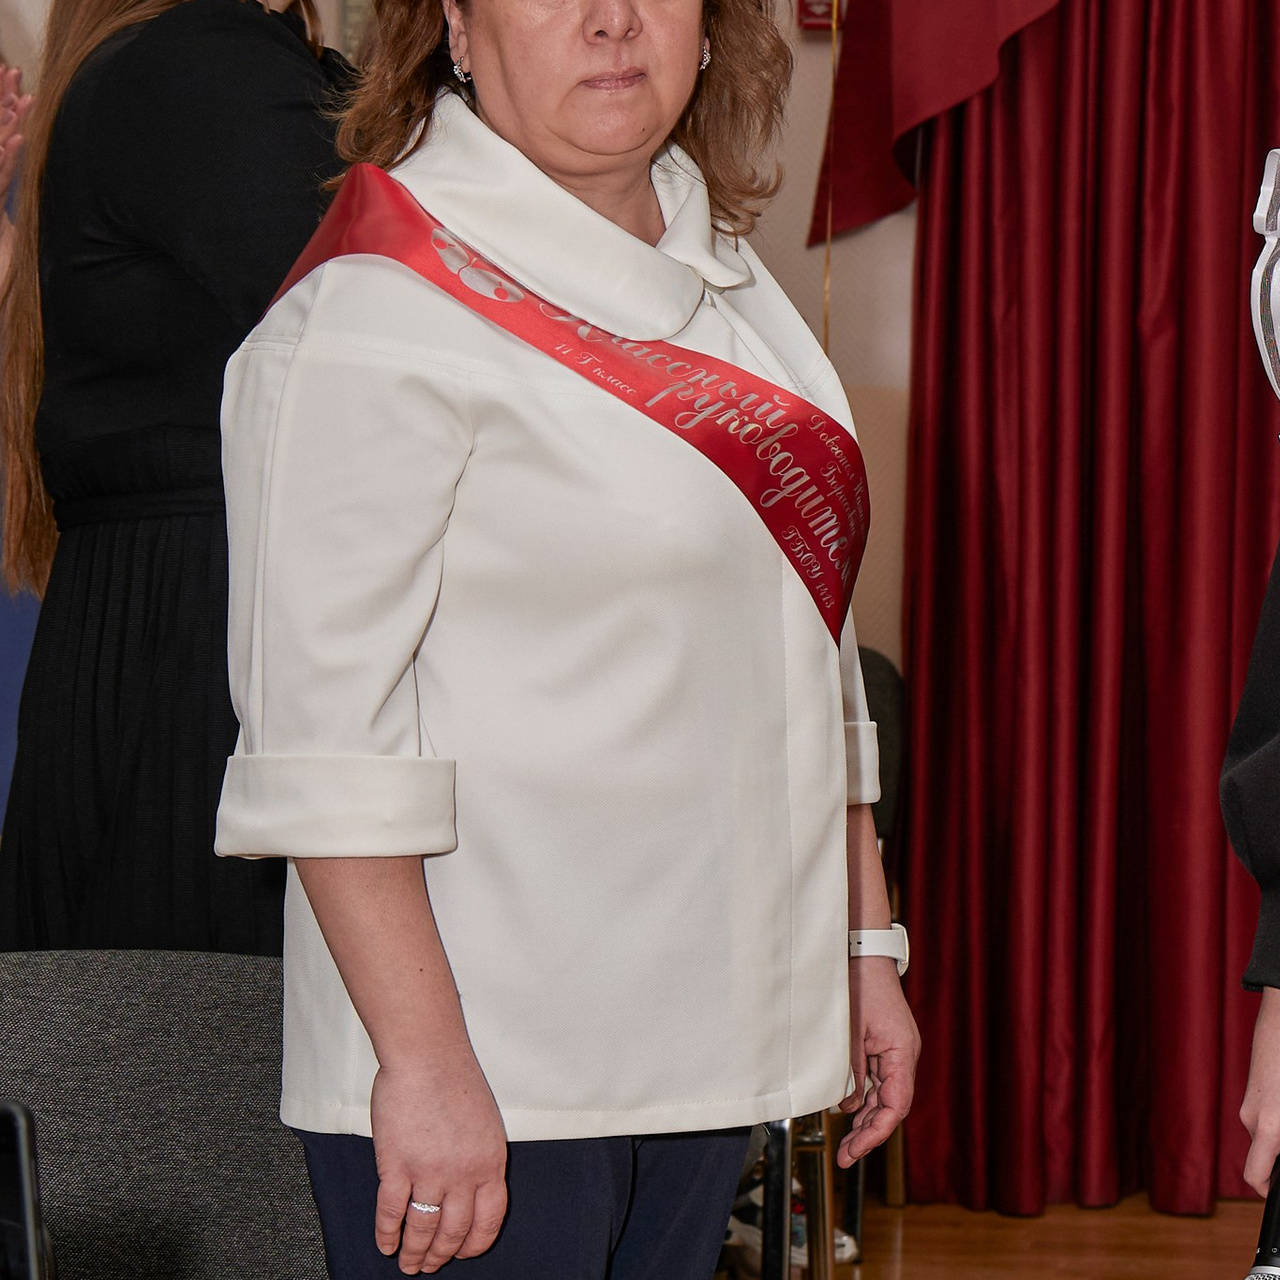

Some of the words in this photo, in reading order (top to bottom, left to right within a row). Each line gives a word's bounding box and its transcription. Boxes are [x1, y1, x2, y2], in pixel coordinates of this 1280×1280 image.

[554, 343, 574, 355] 11
[593, 367, 637, 395] класс
[782, 524, 825, 580] ГБОУ
[815, 581, 836, 609] 1413
